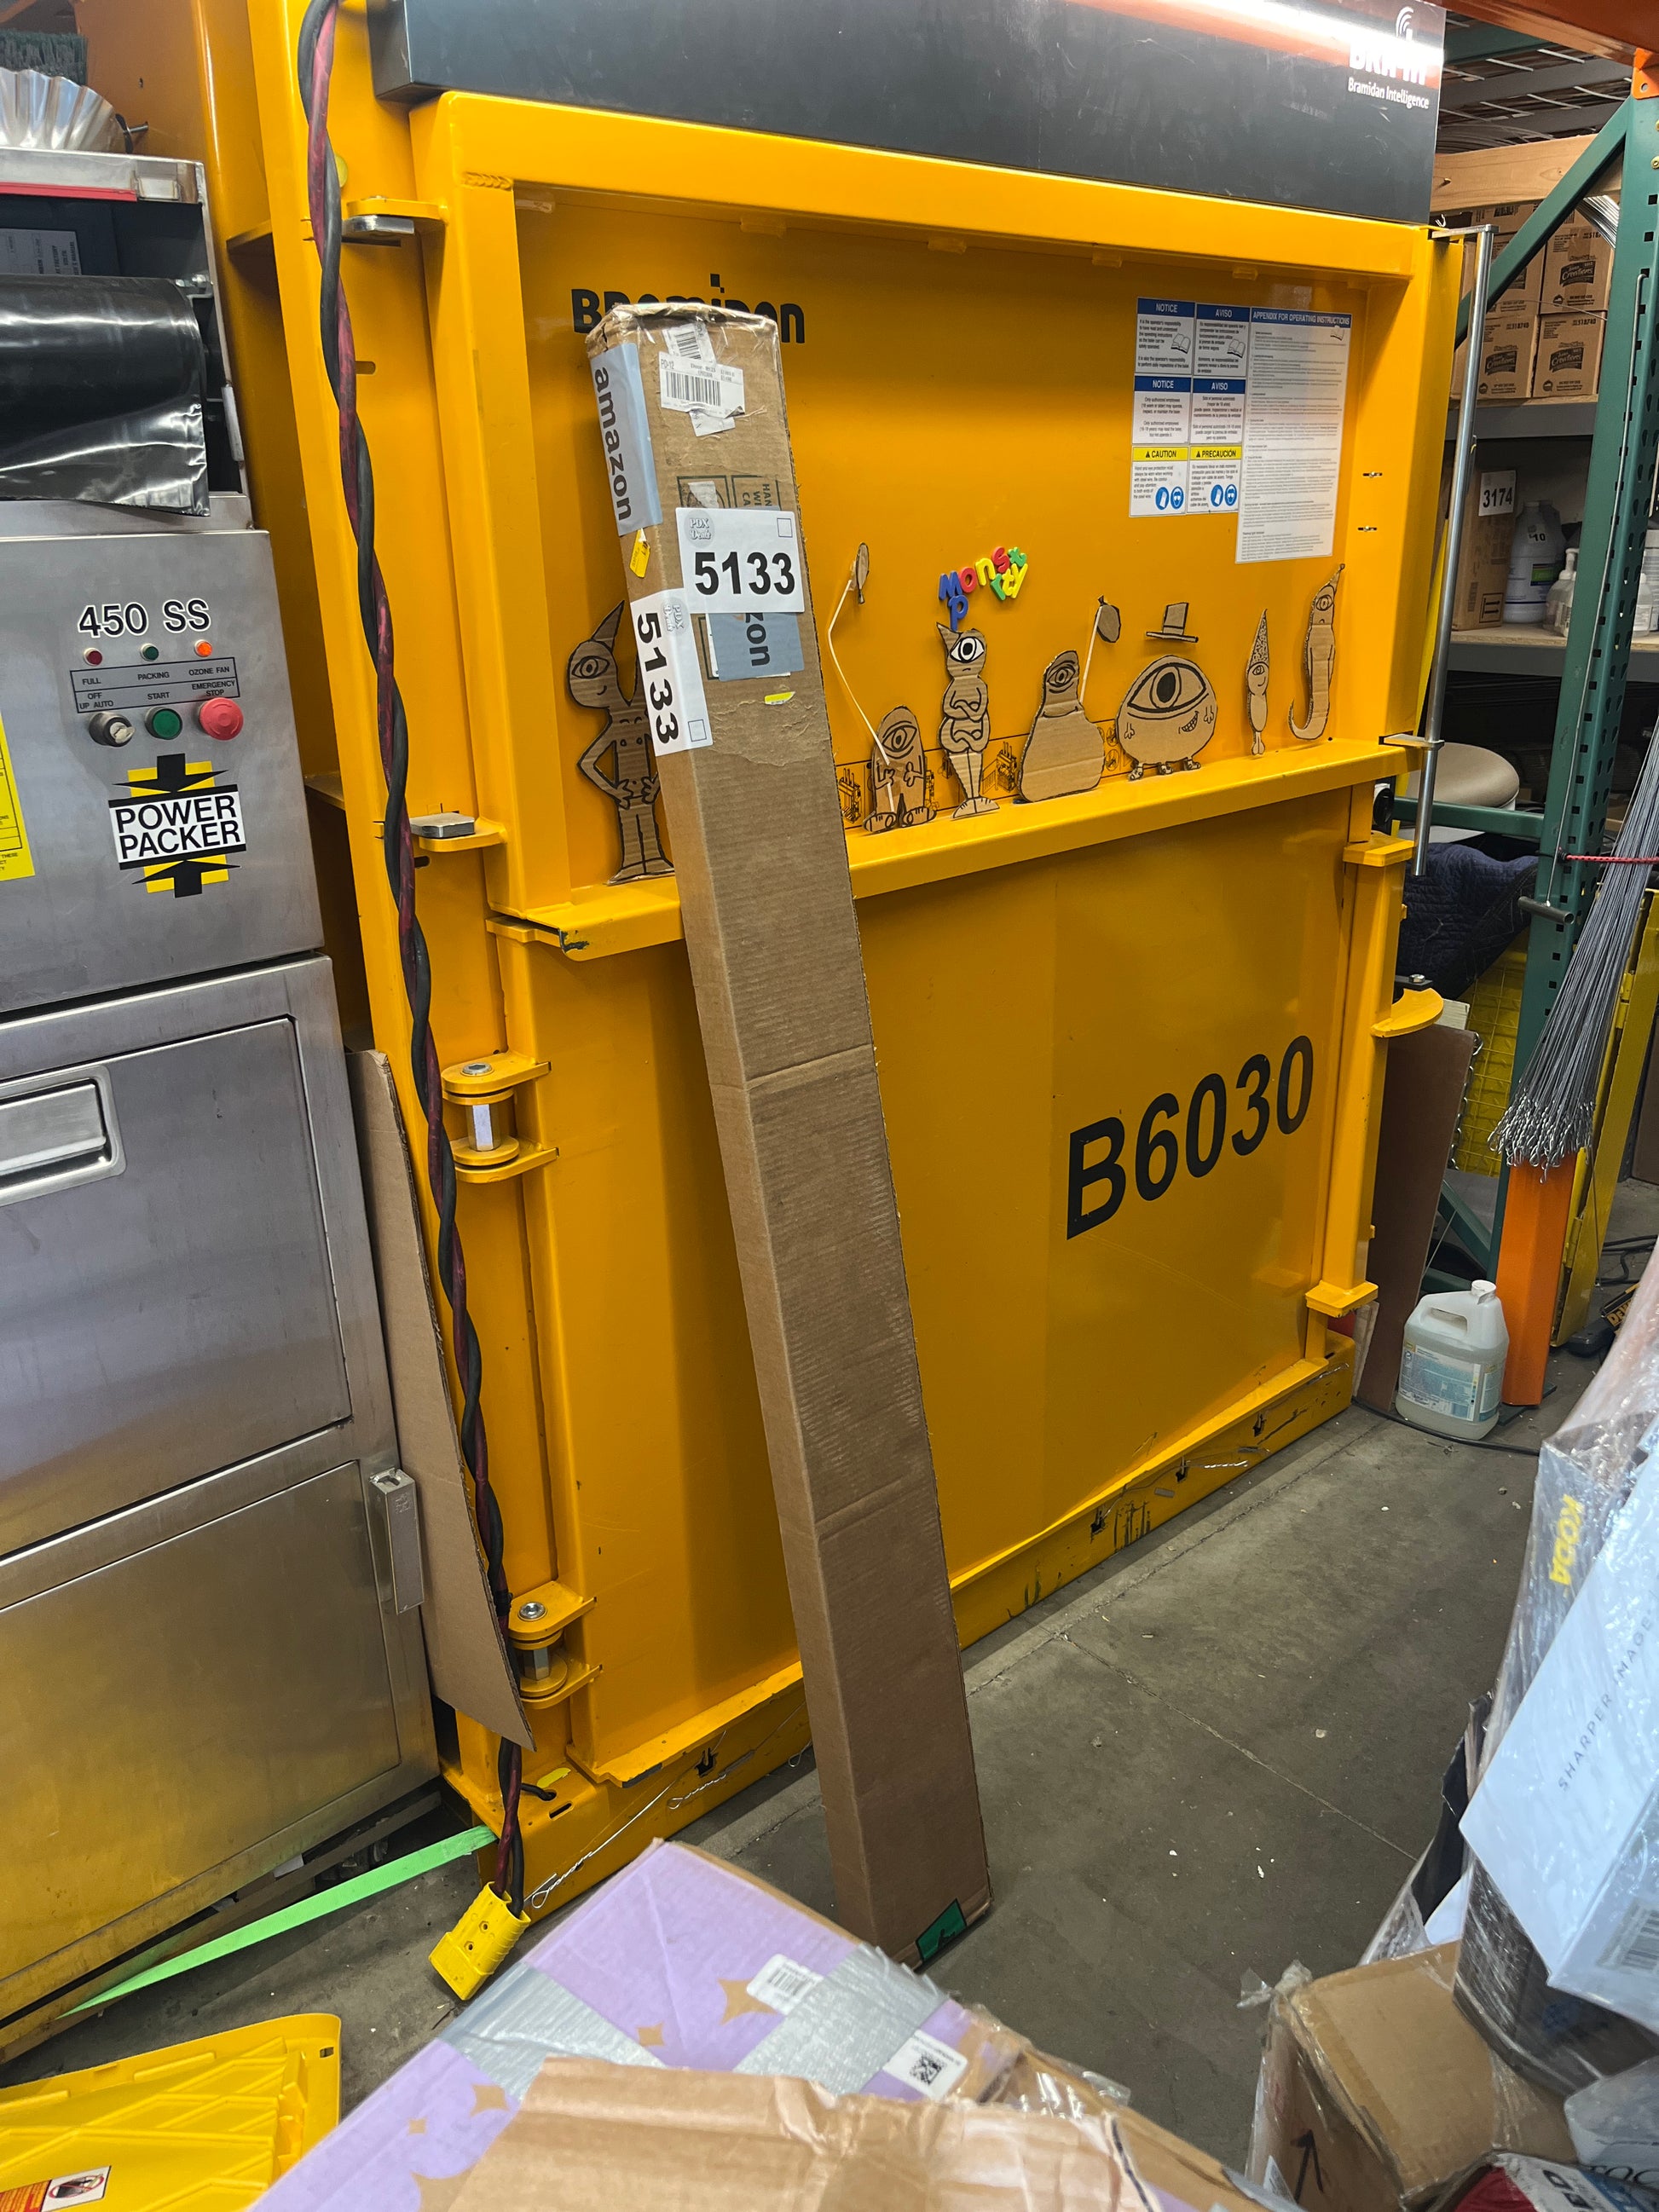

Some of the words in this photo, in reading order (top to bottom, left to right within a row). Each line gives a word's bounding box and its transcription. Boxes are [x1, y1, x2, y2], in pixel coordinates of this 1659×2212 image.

[1348, 77, 1385, 98] Bramidan
[1385, 86, 1430, 109] Intelligence
[1155, 303, 1178, 313] NOTICE
[1215, 309, 1233, 318] AVISO
[1252, 311, 1277, 321] APPENDIX
[1289, 314, 1316, 323] OPERATING
[1316, 315, 1350, 325] INSTRUCTIONS
[1152, 380, 1174, 389] NOTICE
[1211, 382, 1228, 390] AVISO
[594, 367, 632, 521] amazon
[1151, 450, 1177, 459] CAUTION
[1201, 448, 1236, 458] PRECAUCIÓN
[742, 492, 751, 506] CA
[1483, 488, 1512, 508] 3174
[689, 518, 710, 528] PDX
[695, 552, 795, 596] 5133
[78, 602, 148, 638] 450
[163, 598, 211, 633] SS
[673, 604, 685, 629] PDX
[137, 671, 170, 680] PACKING
[188, 667, 213, 676] OZONE
[637, 612, 679, 744] 5133
[192, 679, 235, 690] EMERGENCY
[147, 691, 171, 700] START
[205, 689, 225, 697] STOP
[93, 700, 114, 708] AUTO
[115, 794, 237, 834] POWER
[118, 820, 240, 860] PACKER
[1066, 1035, 1314, 1241] B6030
[1548, 1493, 1584, 1585] KODA
[1558, 1694, 1612, 1791] SHARPER
